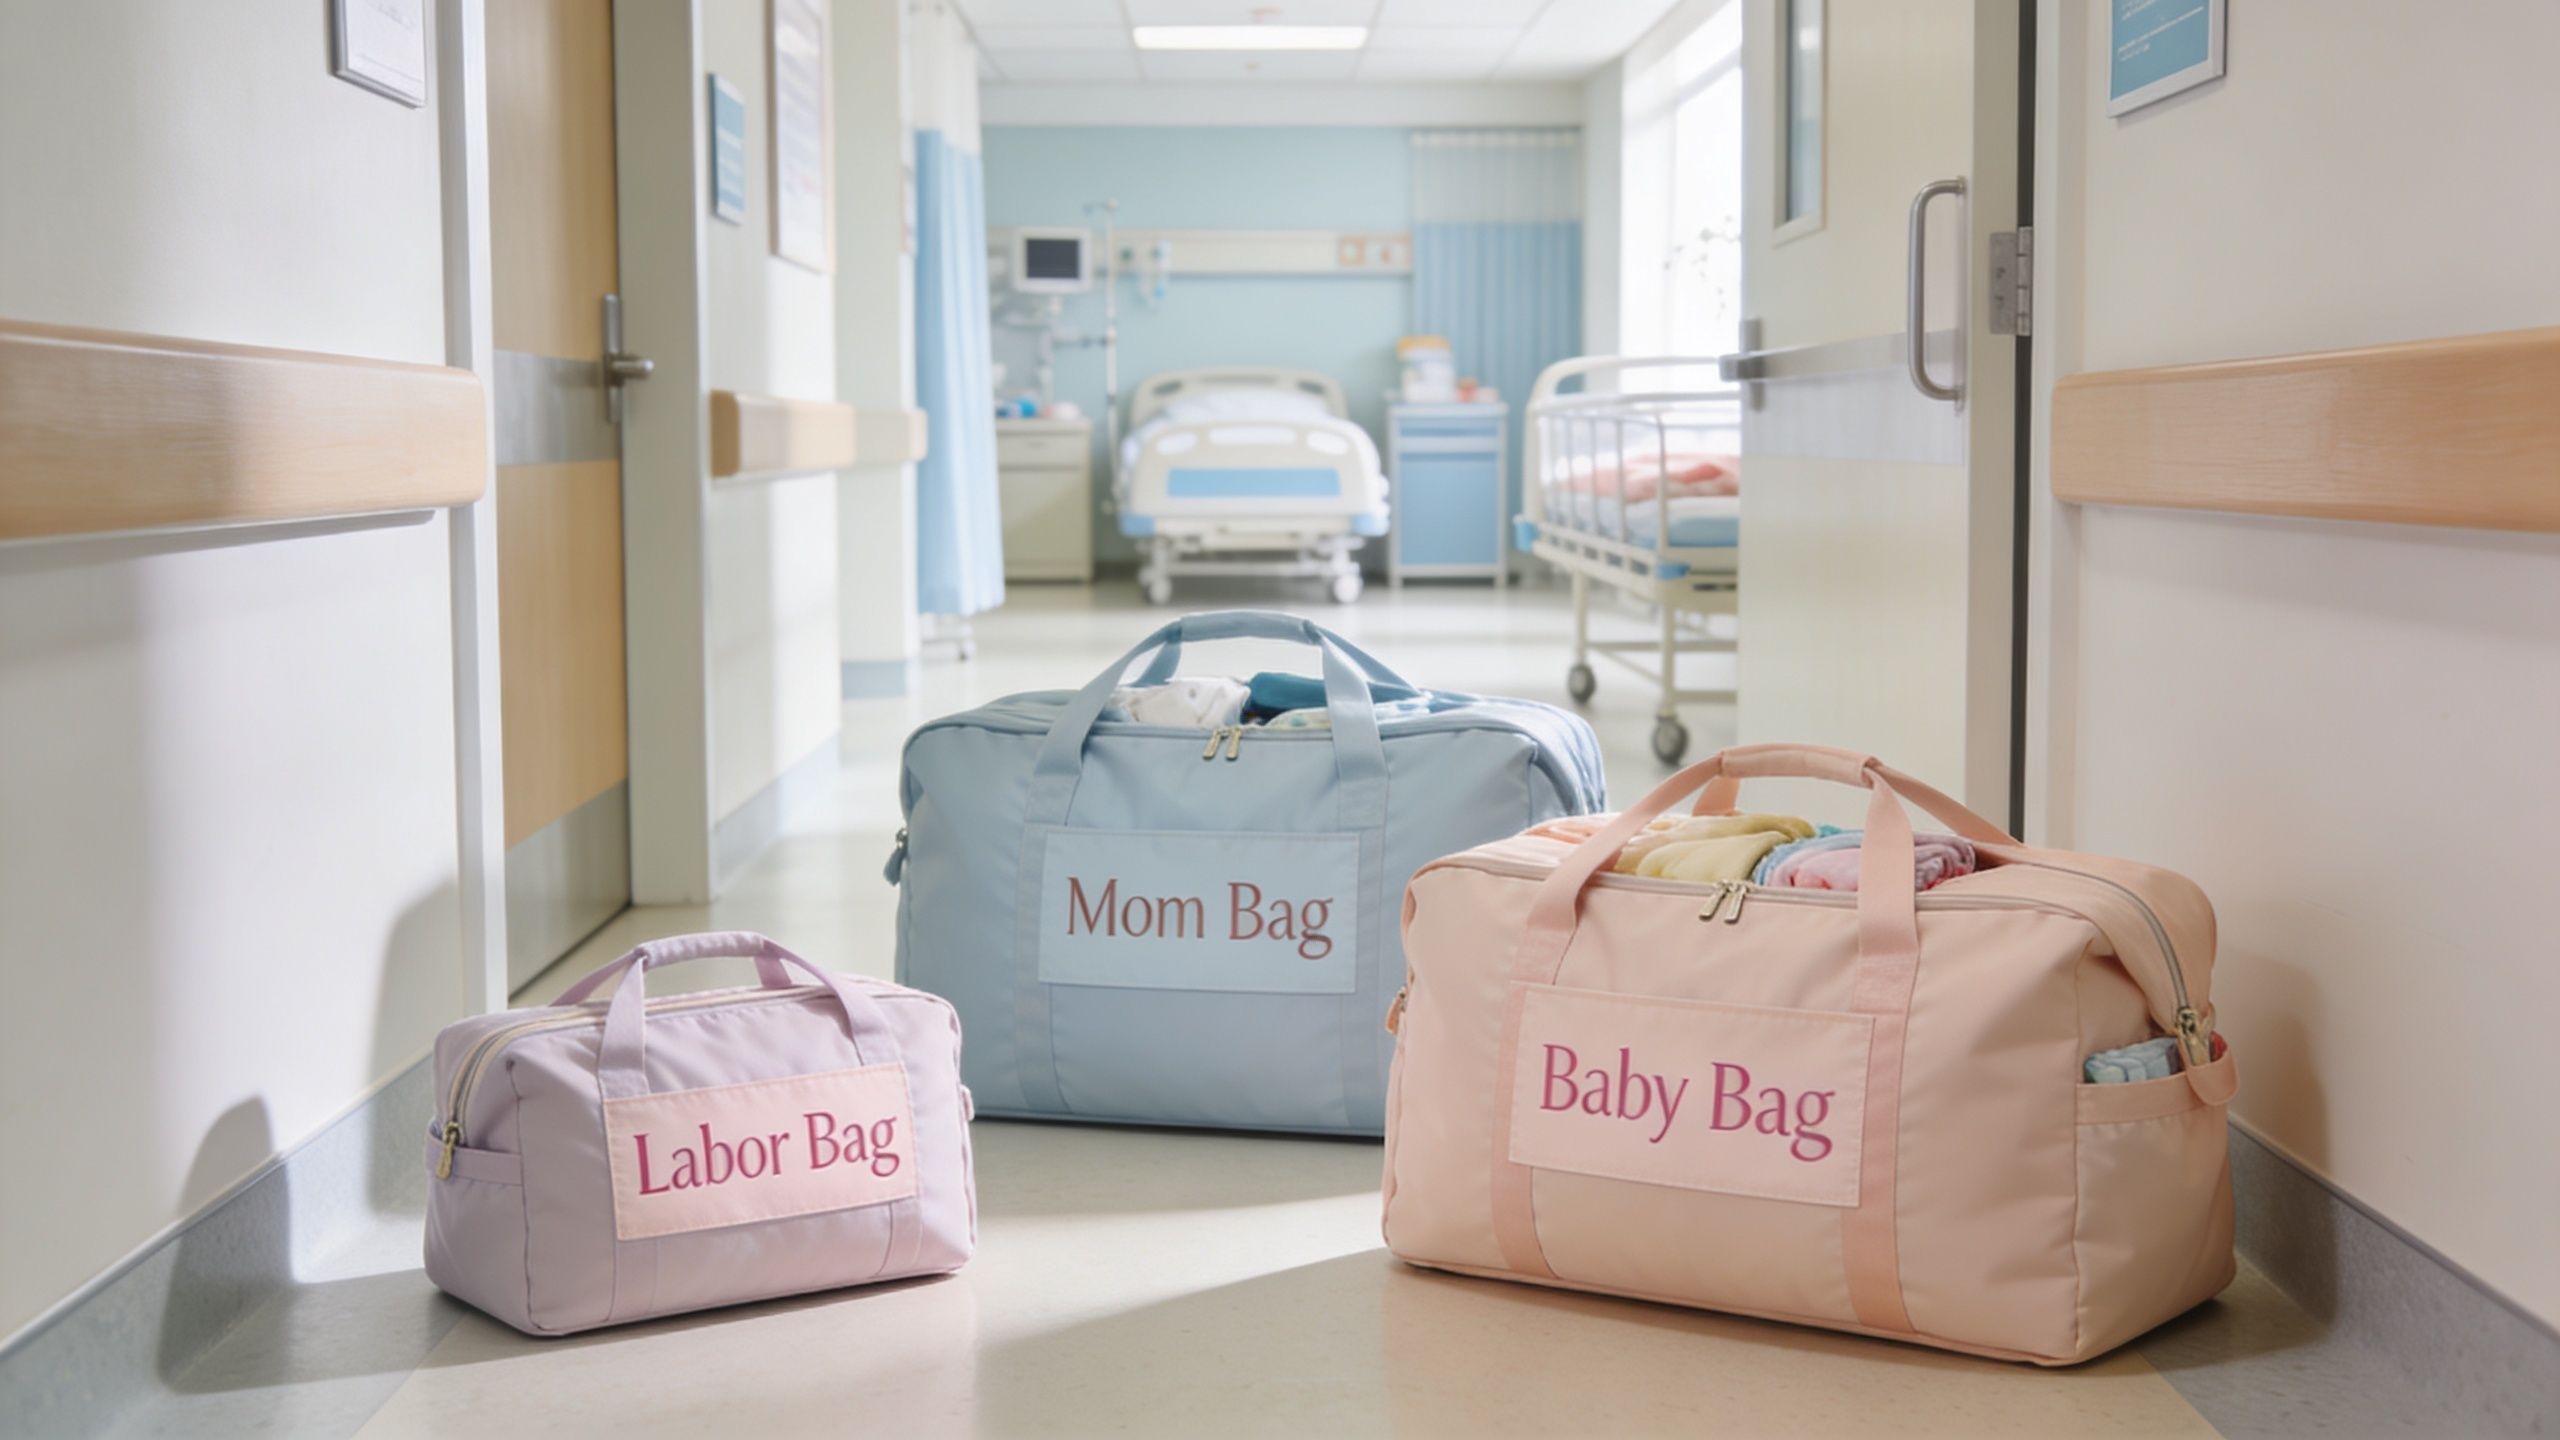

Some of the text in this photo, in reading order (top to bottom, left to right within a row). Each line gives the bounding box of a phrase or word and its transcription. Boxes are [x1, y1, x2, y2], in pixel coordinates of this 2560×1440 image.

[1067, 877, 1333, 960] Mom Bag
[1540, 1044, 1836, 1162] Baby Bag
[634, 1112, 901, 1194] Labor Bag
